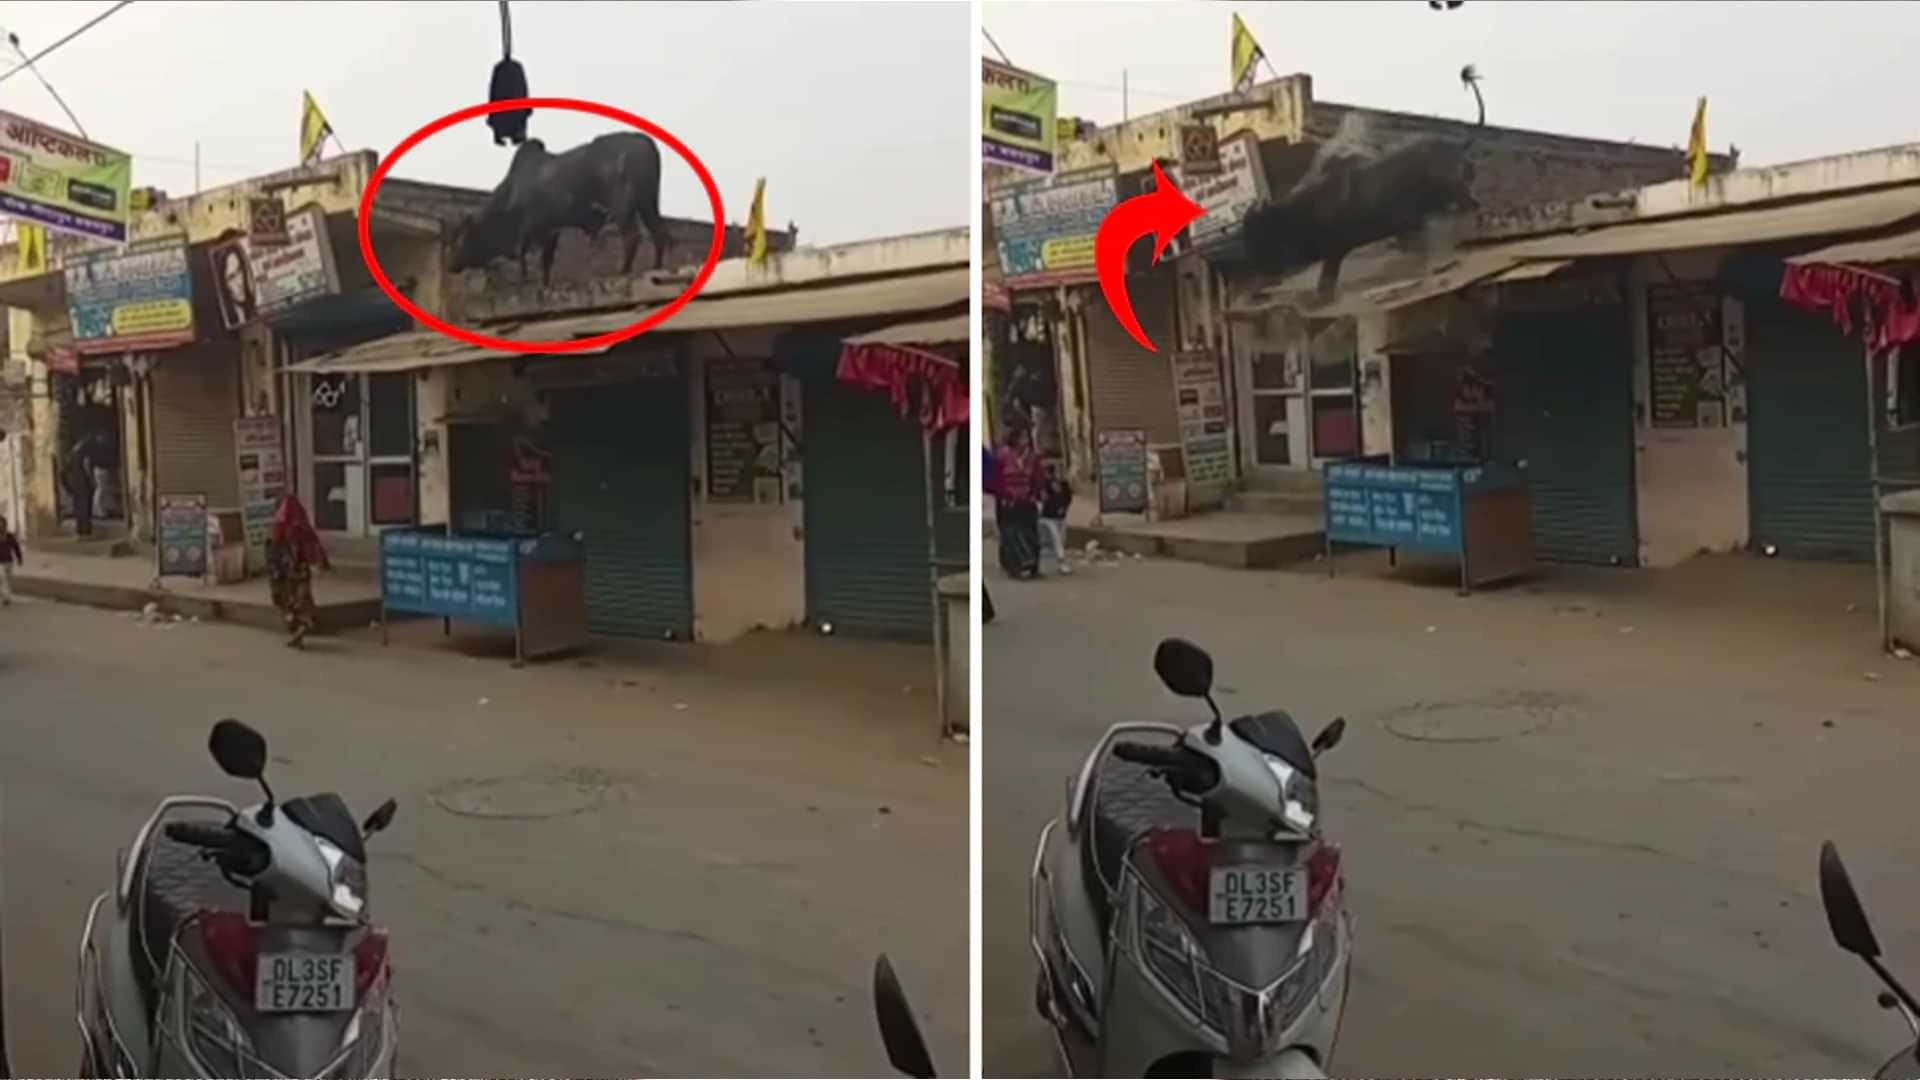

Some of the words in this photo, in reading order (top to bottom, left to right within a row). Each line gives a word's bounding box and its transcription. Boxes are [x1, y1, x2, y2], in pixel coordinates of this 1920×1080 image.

[1226, 872, 1296, 895] DL3SF
[1226, 896, 1295, 920] E7251
[273, 958, 342, 982] DL3SF
[273, 983, 341, 1007] E7251
